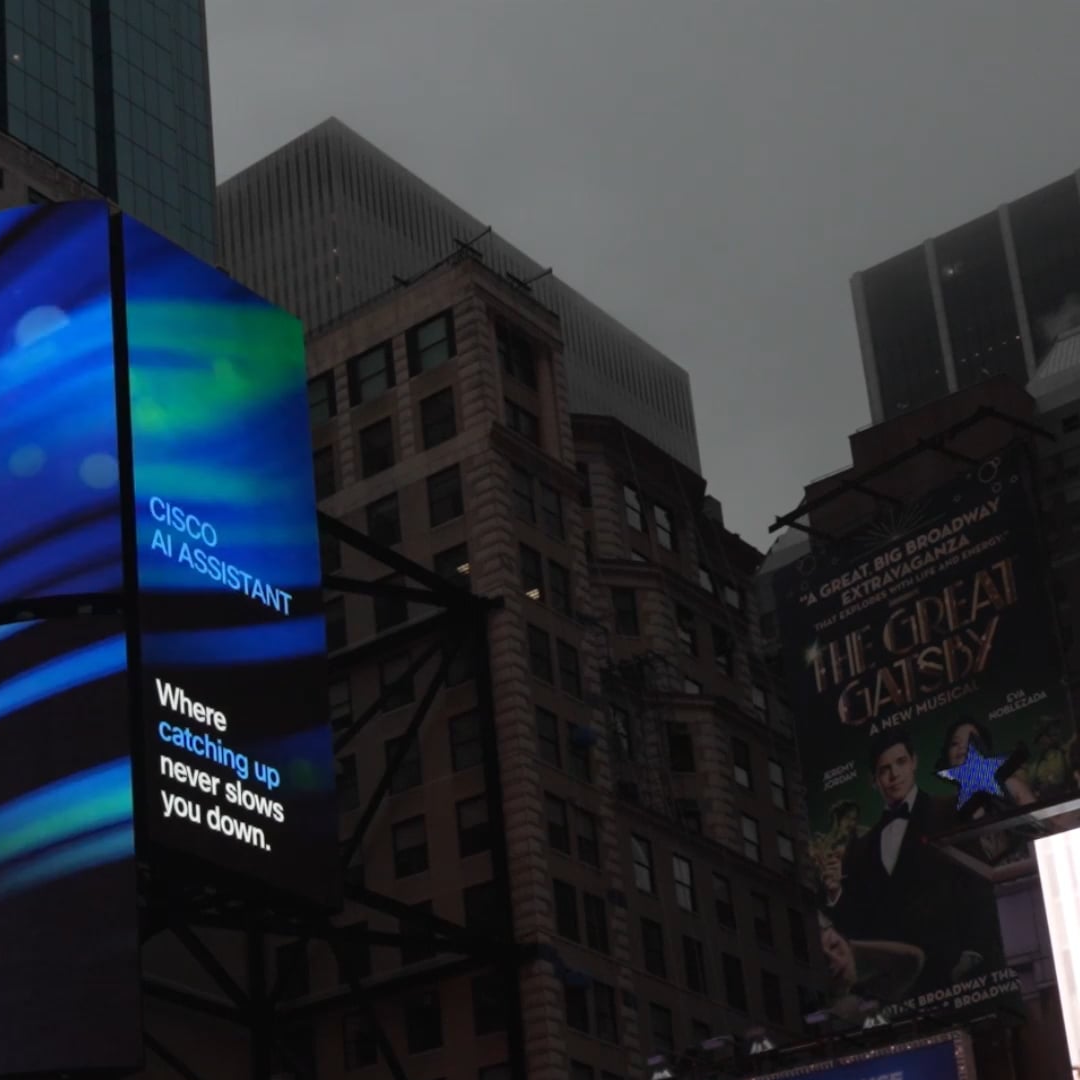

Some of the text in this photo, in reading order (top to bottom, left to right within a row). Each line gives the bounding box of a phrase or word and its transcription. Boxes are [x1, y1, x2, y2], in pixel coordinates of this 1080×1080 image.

[149, 495, 218, 548] CISCO
[874, 548, 902, 571] BIG
[905, 497, 1001, 553] BROADWAY
[150, 530, 293, 616] AI ASSISTANT
[841, 534, 970, 605] EXTRAVAGANZA
[808, 558, 1018, 693] THE GREAT
[156, 678, 227, 732] Where
[838, 615, 1001, 726] GATSBY
[869, 680, 980, 737] A NEW MUSICAL
[158, 719, 281, 790] catching up
[160, 753, 286, 823] never slows
[161, 787, 273, 851] you down.
[917, 974, 987, 1006] BROADWAY
